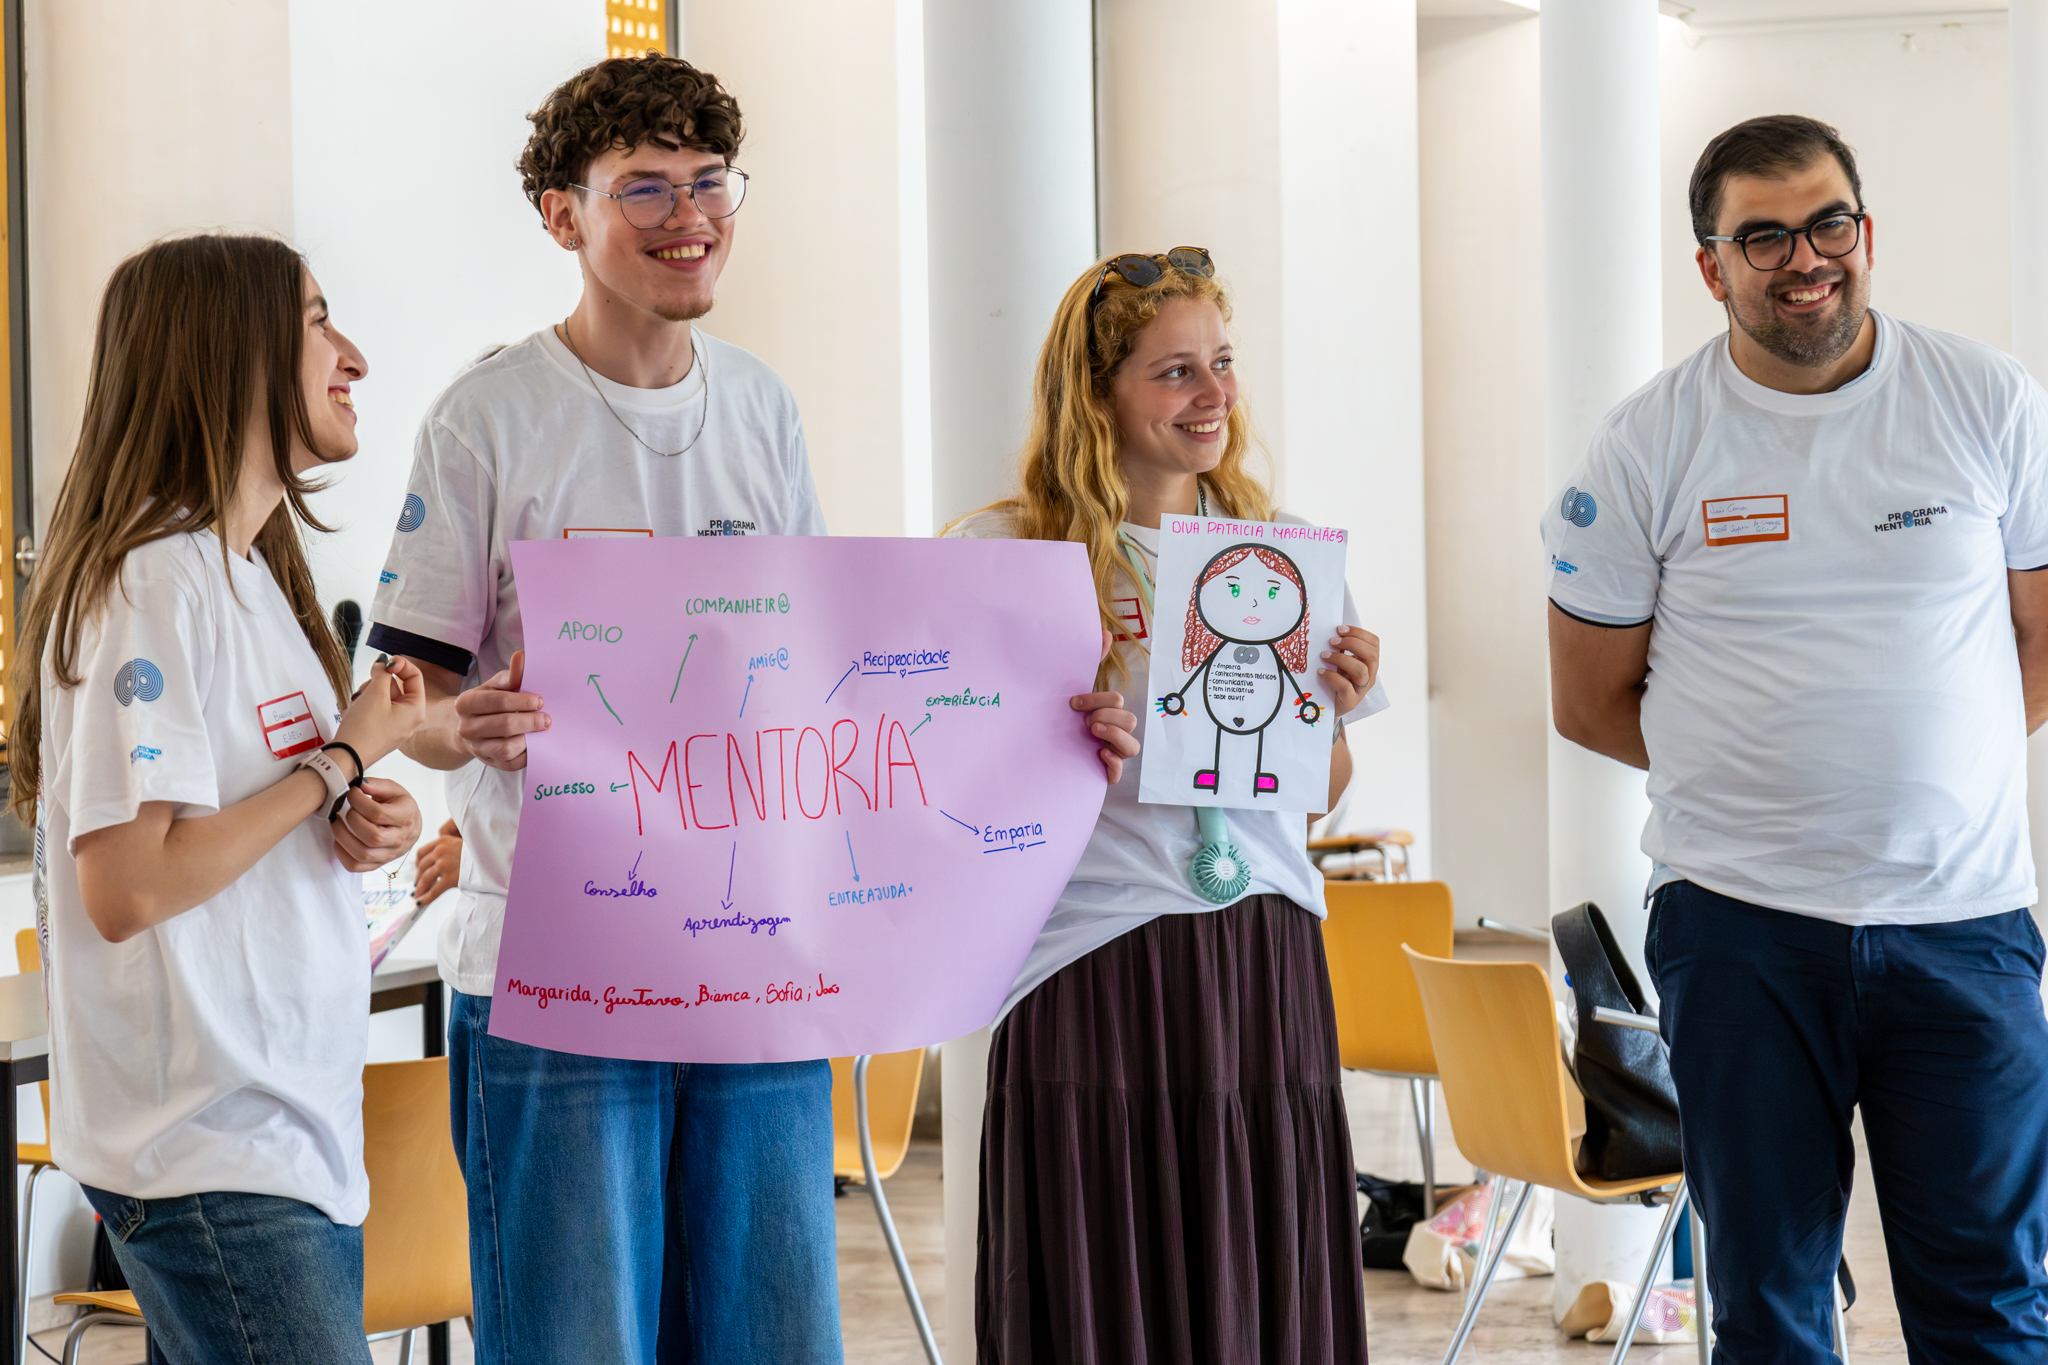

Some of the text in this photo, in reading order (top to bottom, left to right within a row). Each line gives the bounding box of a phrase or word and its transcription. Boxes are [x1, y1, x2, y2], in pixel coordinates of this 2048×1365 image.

[709, 519, 756, 531] PROGRAMA
[1874, 517, 1932, 533] MENTORIA
[1888, 506, 1948, 522] PROGRAMA
[1172, 520, 1344, 544] DIVA PATRICIA MAGALHÃES
[686, 593, 790, 615] COMPANHEIR@
[558, 621, 623, 643] APOIO
[863, 649, 950, 673] Reciprocidade
[628, 713, 930, 836] MENTORIA
[534, 782, 596, 801] SUCESSO
[983, 822, 1043, 845] Empatia
[583, 880, 658, 898] Conselho
[828, 882, 907, 907] ENTREAJUDA
[682, 911, 792, 938] Aprendizagem
